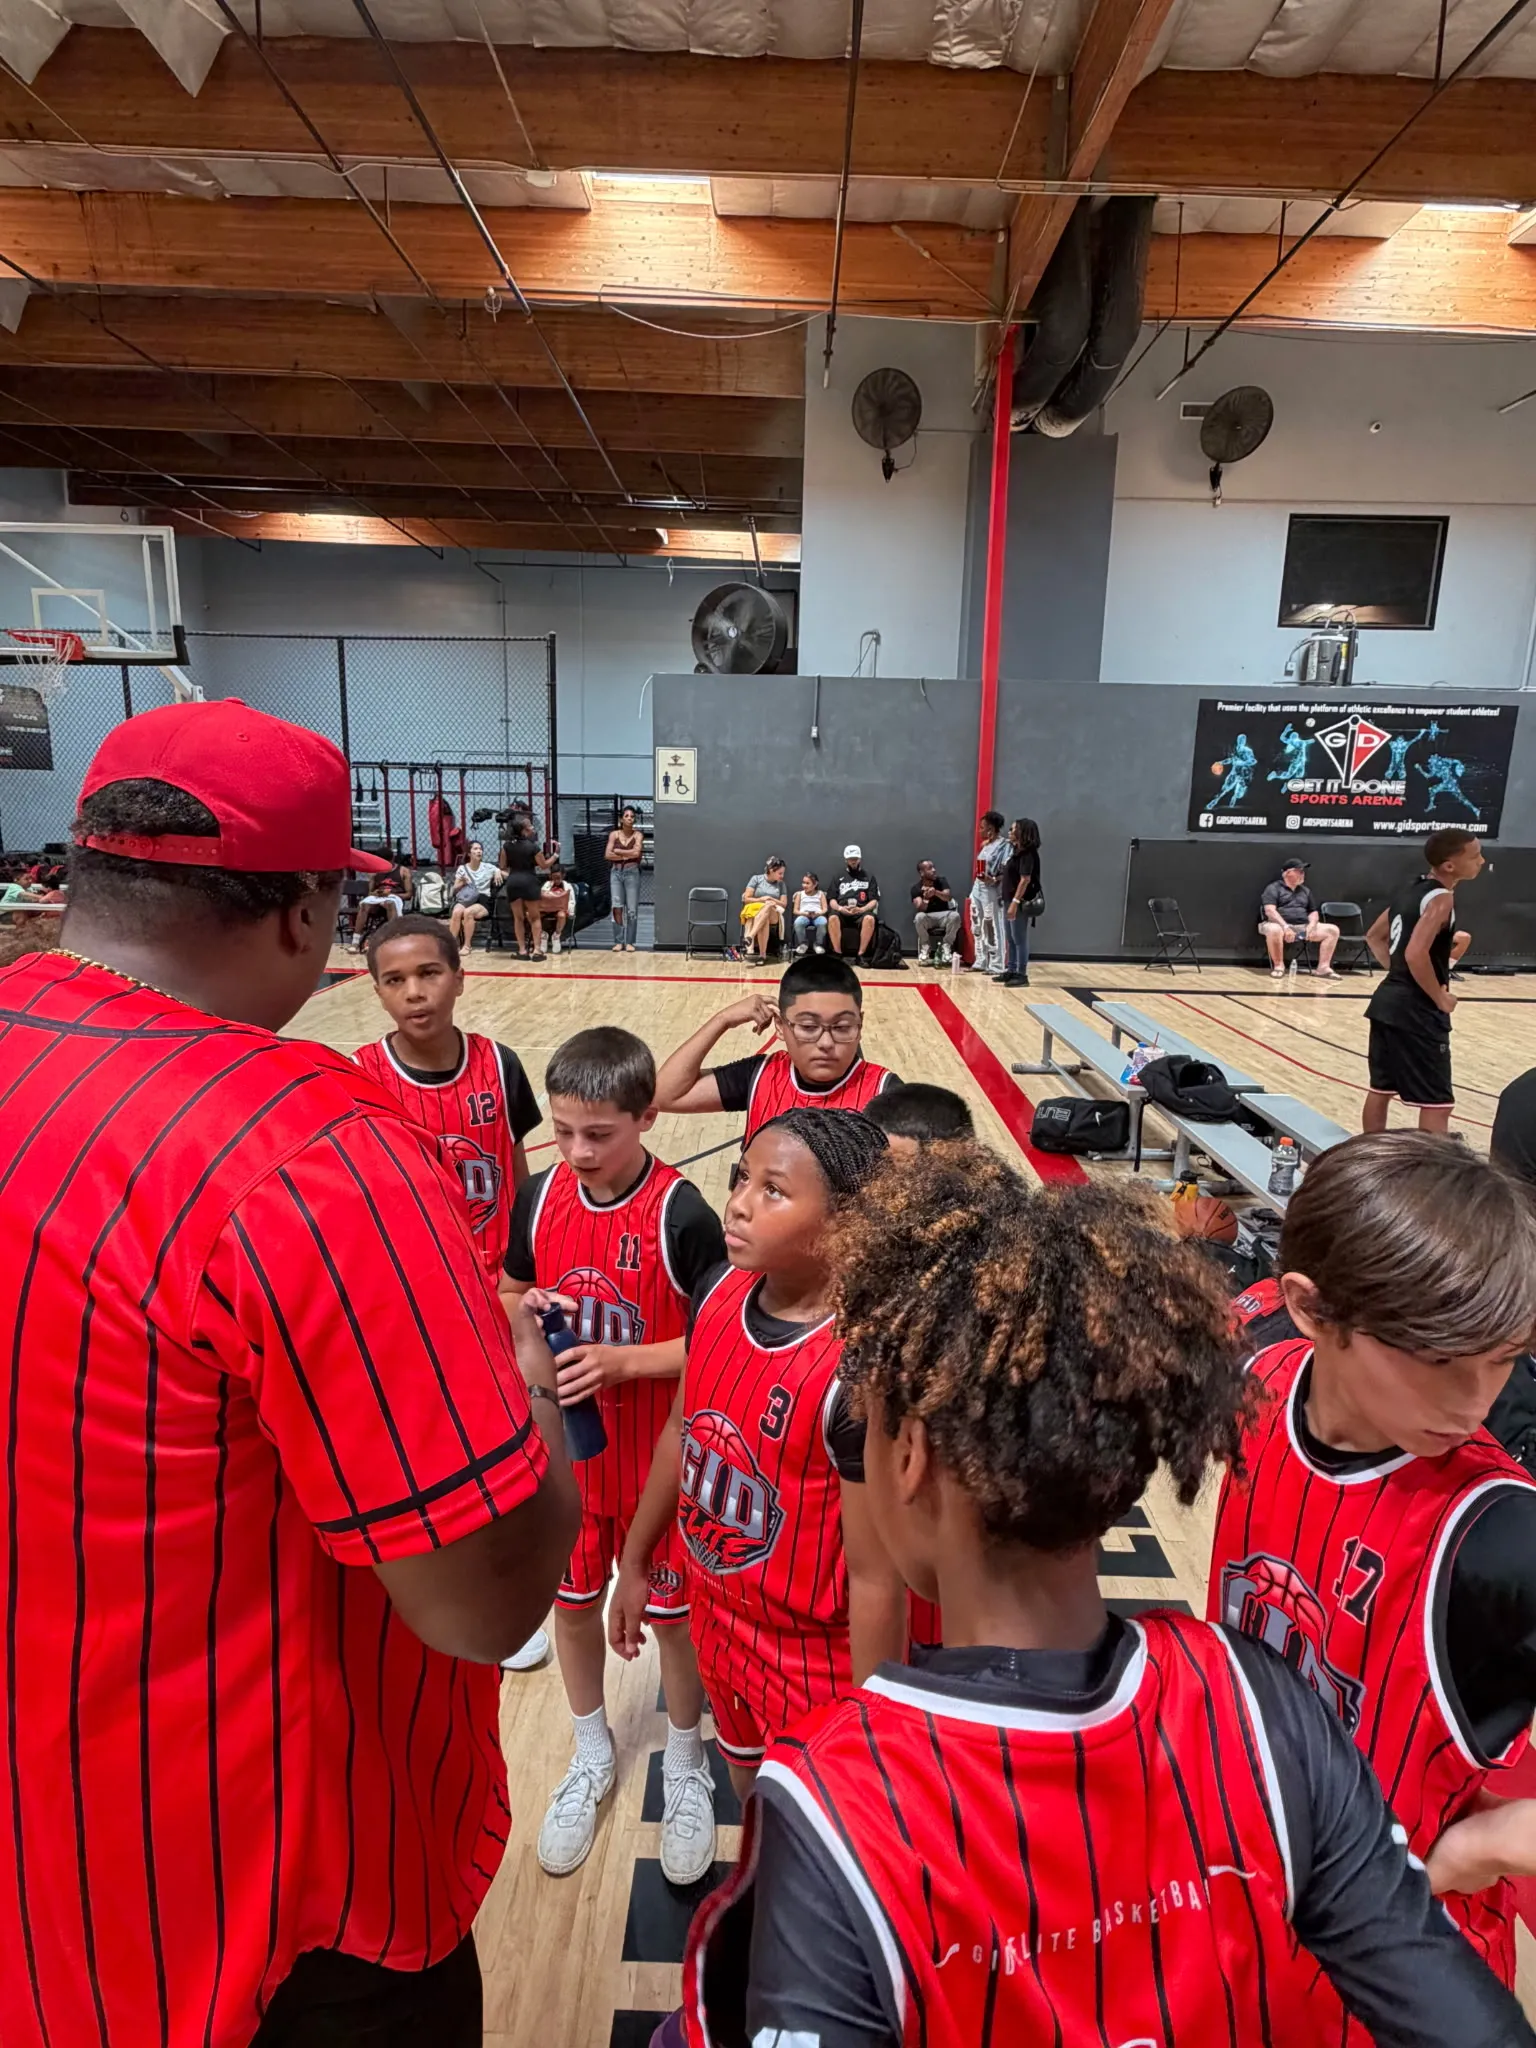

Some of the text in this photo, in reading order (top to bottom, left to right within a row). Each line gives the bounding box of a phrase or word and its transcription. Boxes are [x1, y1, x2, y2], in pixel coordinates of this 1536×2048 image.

[1217, 701, 1244, 712] Premier
[1245, 703, 1267, 714] facility
[1268, 703, 1281, 712] that
[1298, 703, 1310, 712] the
[1310, 704, 1338, 714] platform
[1339, 704, 1347, 713] of
[1347, 704, 1371, 713] athletic
[1372, 705, 1406, 714] excellence
[1407, 706, 1414, 715] to
[1415, 707, 1445, 716] empower
[1446, 707, 1471, 716] student
[1471, 707, 1500, 716] athletes!
[1287, 778, 1406, 795] GET IT DONE
[1290, 794, 1403, 806] SPORTS ARENA
[1216, 815, 1267, 826] GIDSPORTSARENA
[1303, 817, 1354, 828] GIDSPORTSARENA
[1373, 819, 1488, 833] www.gidsportsarena.com
[466, 1090, 498, 1128] 12
[616, 1232, 642, 1272] 11
[563, 1295, 633, 1346] ID
[759, 1383, 793, 1441] 3
[680, 1433, 767, 1540] GID
[1332, 1536, 1385, 1626] 17
